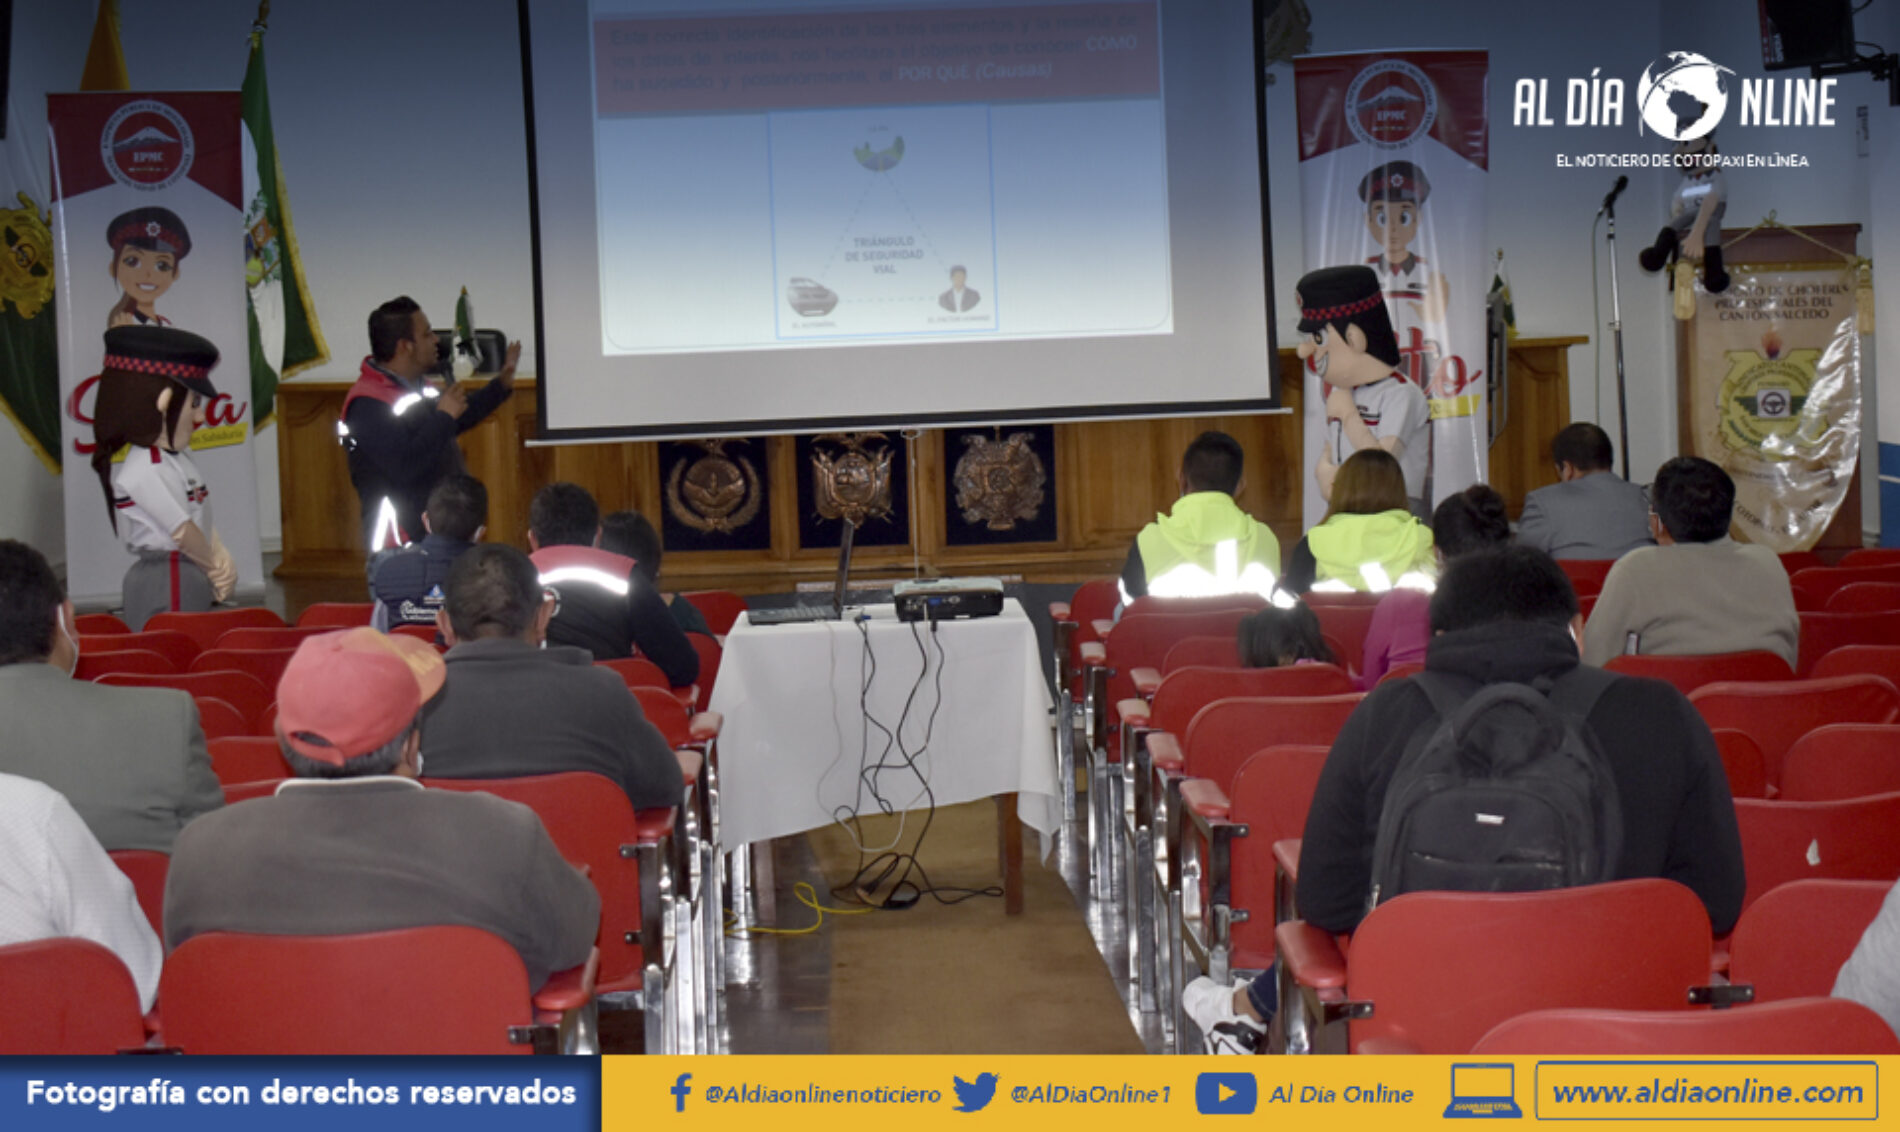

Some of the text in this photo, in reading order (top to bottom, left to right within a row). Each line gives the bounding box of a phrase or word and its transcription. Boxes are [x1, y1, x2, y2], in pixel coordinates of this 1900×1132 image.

[898, 65, 932, 80] POR
[845, 248, 924, 263] DE SEGURIDAD
